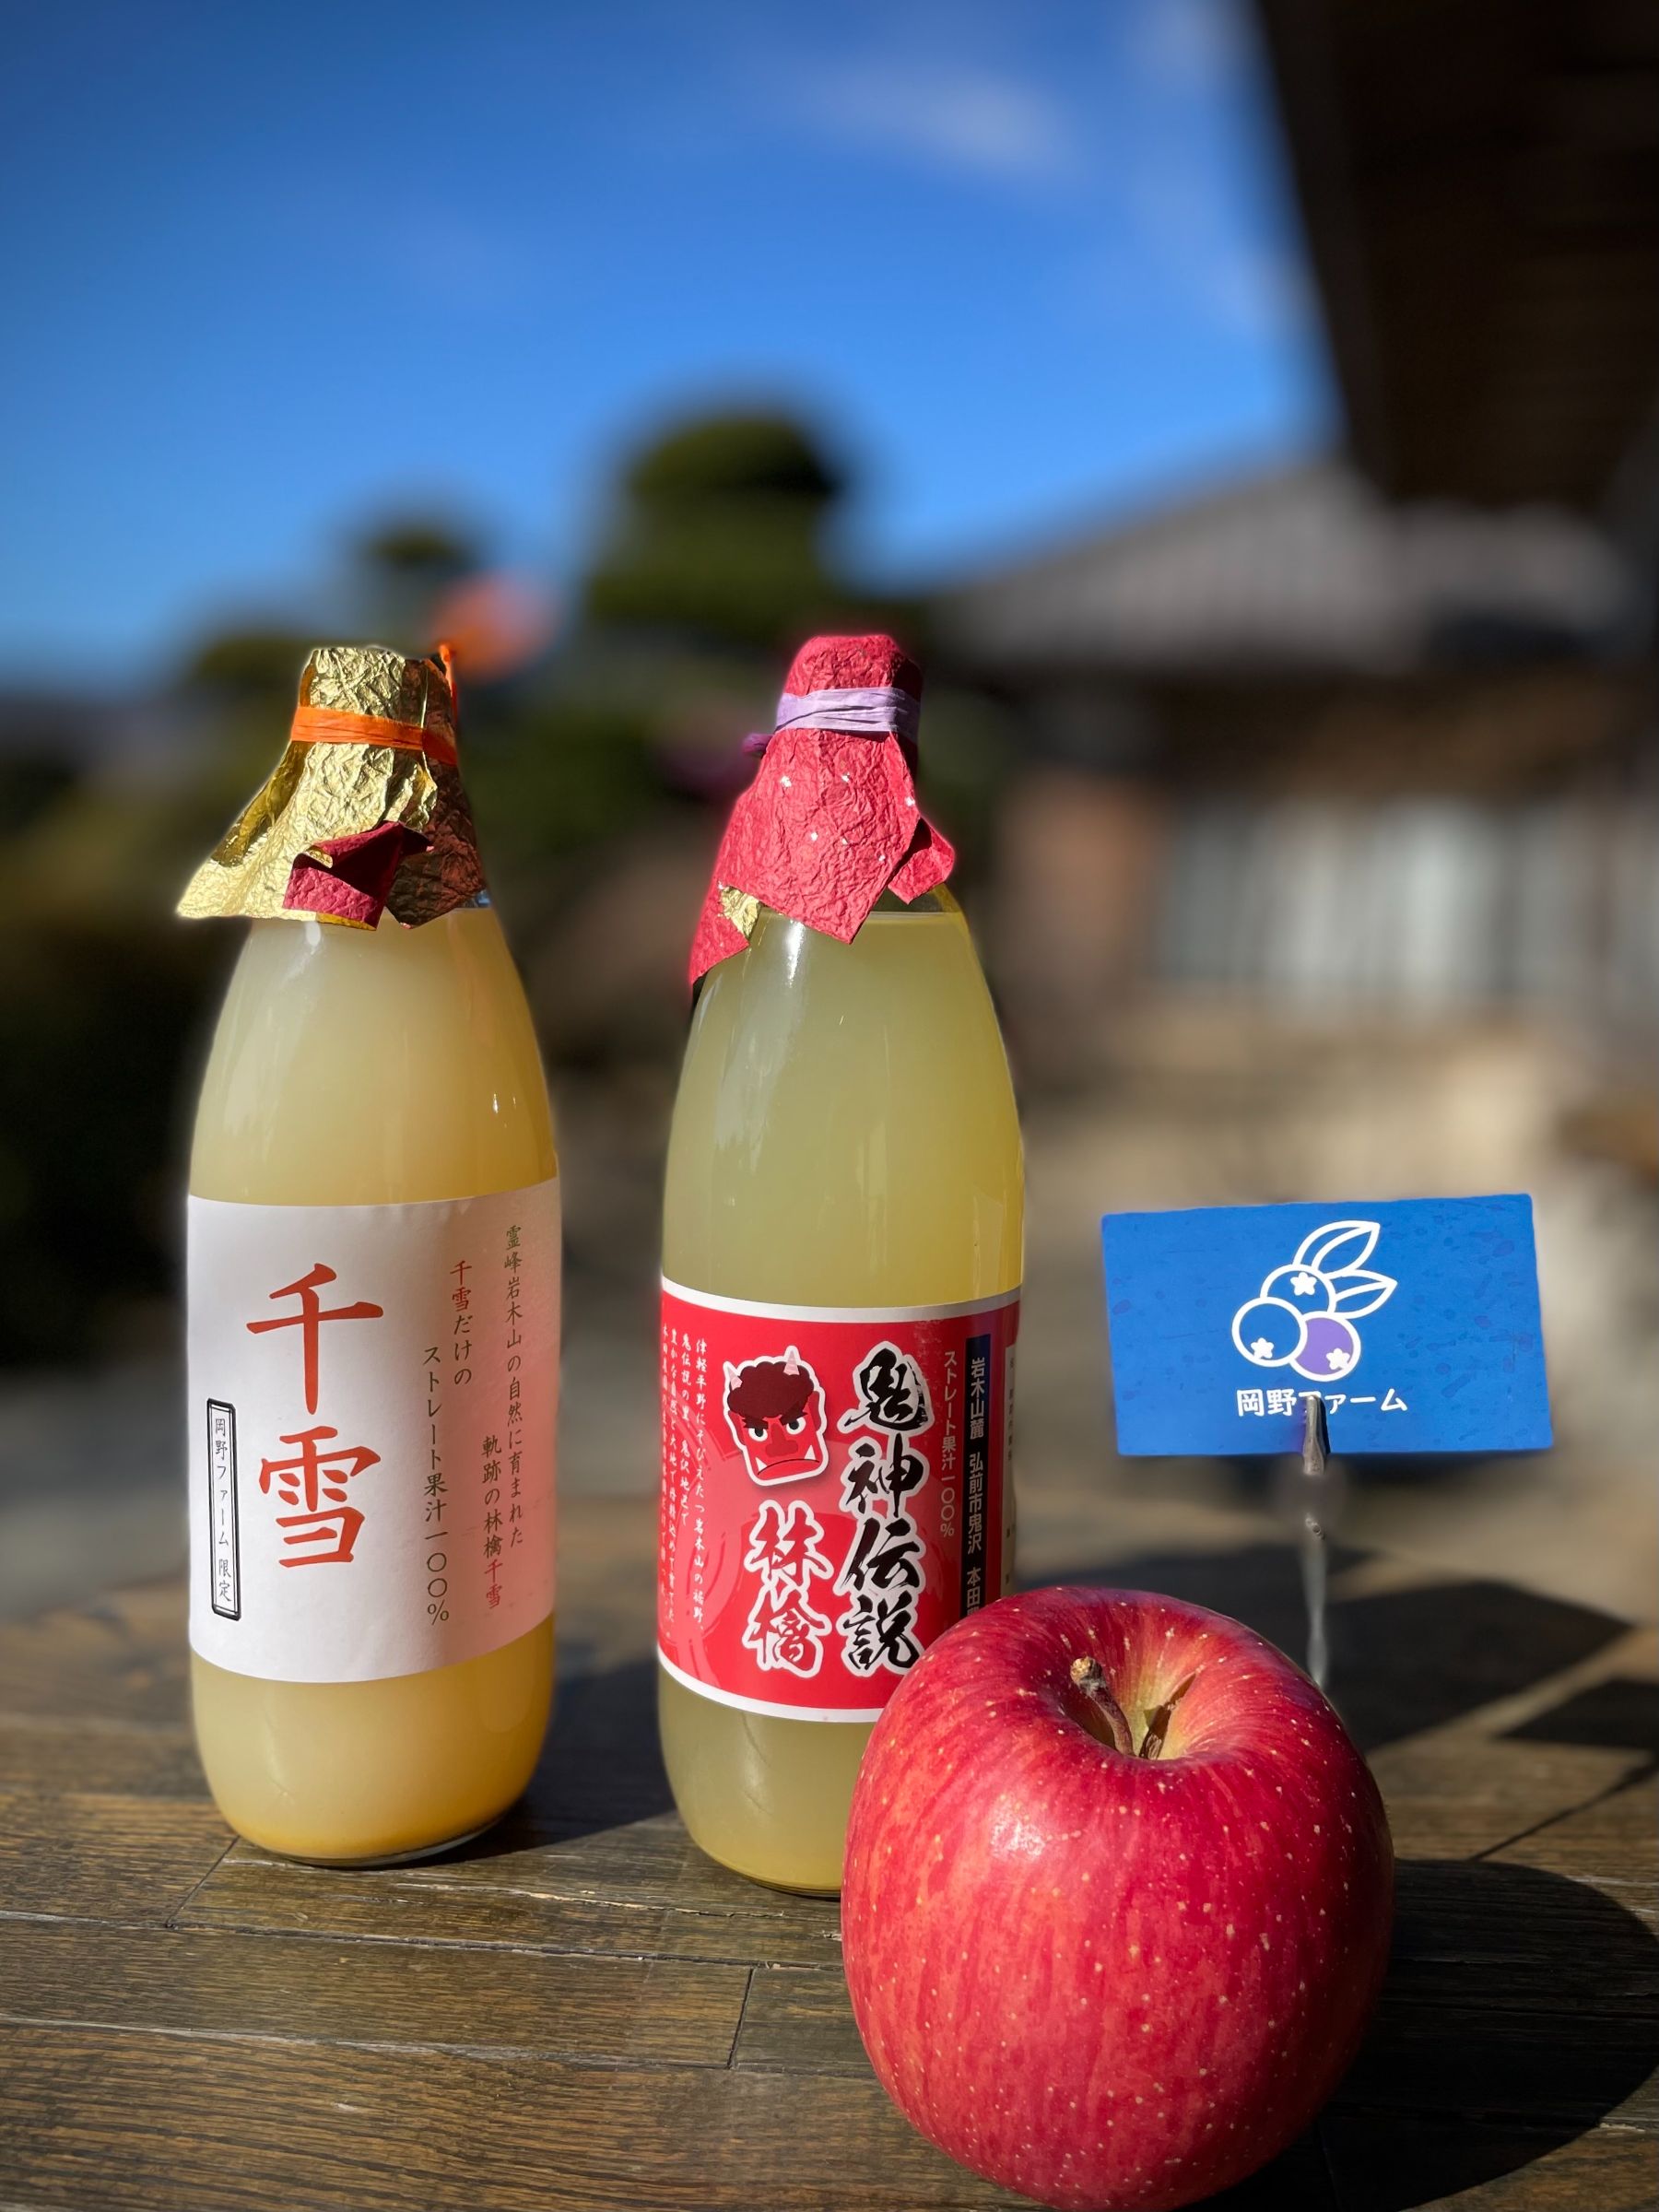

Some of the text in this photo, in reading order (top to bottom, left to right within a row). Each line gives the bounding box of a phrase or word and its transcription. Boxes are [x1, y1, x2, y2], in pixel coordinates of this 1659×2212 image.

[449, 1259, 473, 1387] 千雪だけの
[504, 1224, 524, 1548] 霊峰岩木山の自然に育まれた
[970, 1356, 985, 1440] 岩木山麓
[246, 1262, 383, 1569] 千雪
[215, 1418, 231, 1603] 岡野ファーム 限定
[481, 1435, 503, 1609] 軌跡の林檎千雪
[745, 1502, 831, 1675] 林檎
[840, 1344, 931, 1674] 鬼神伝説
[968, 1452, 983, 1555] 弘前市鬼沢
